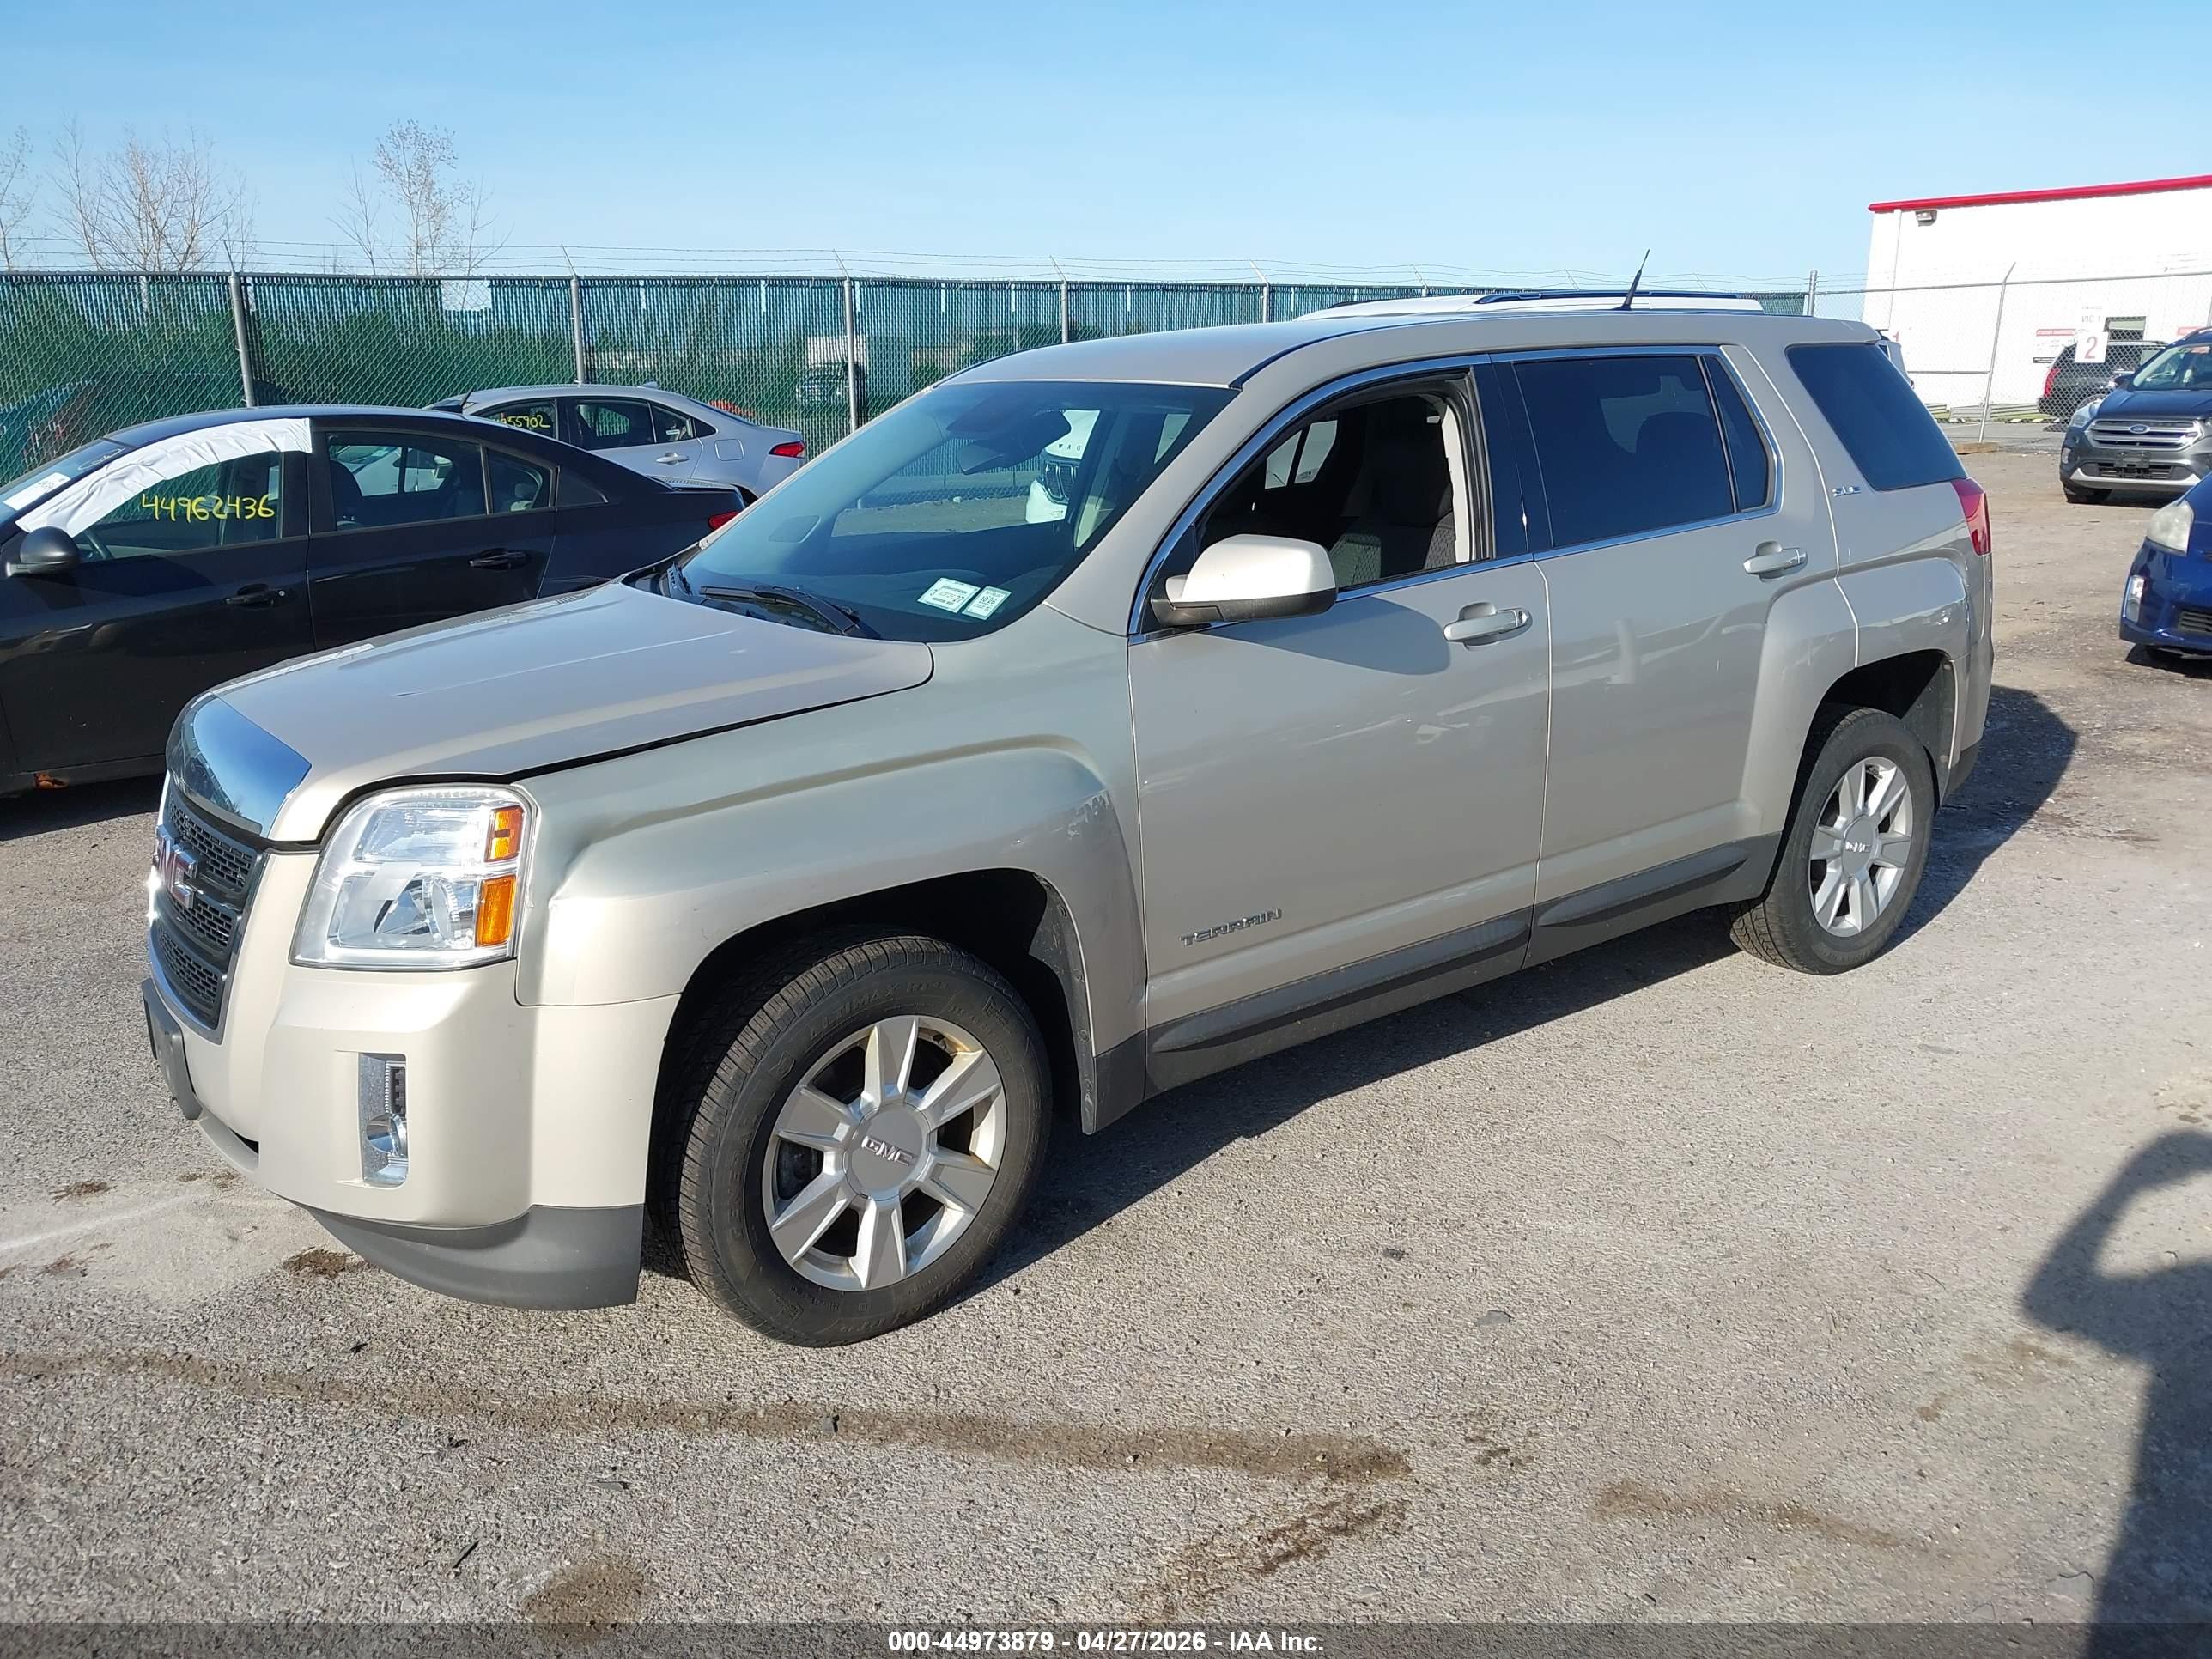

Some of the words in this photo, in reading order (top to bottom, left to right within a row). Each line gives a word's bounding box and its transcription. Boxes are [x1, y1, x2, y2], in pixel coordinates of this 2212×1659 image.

[2084, 336, 2098, 359] 2
[142, 493, 276, 524] 44962436
[1178, 908, 1283, 947] TERRAIN
[860, 1135, 914, 1168] GMC
